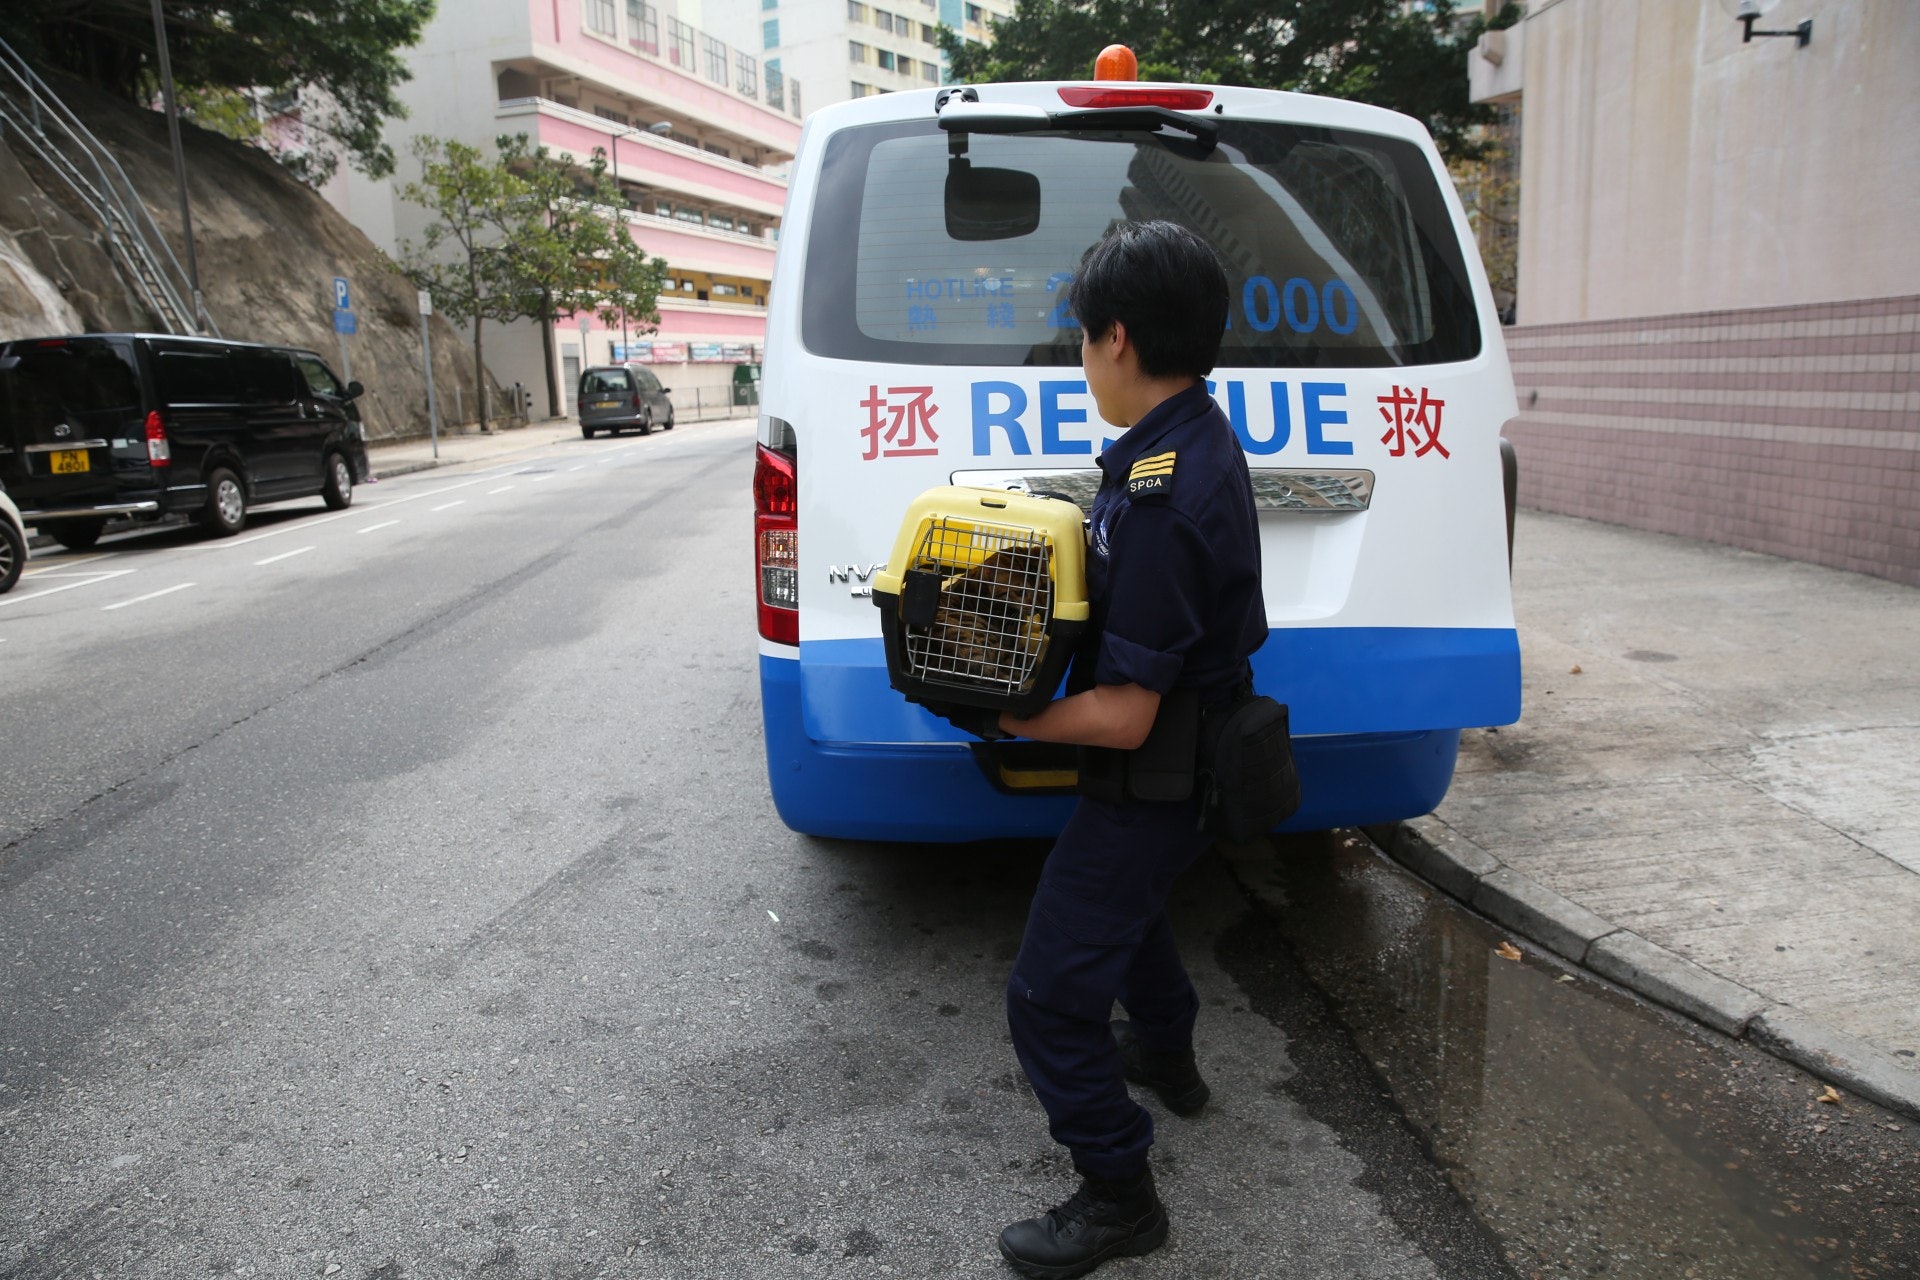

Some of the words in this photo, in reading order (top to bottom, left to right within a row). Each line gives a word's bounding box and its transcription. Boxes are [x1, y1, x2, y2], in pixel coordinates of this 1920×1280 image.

[335, 280, 347, 306] P
[907, 277, 1015, 300] HOTLINE
[1225, 275, 1359, 335] 000
[860, 385, 939, 461] 拯
[971, 381, 1354, 456] REUE
[1377, 385, 1450, 460] 救
[1130, 477, 1162, 493] SPCA
